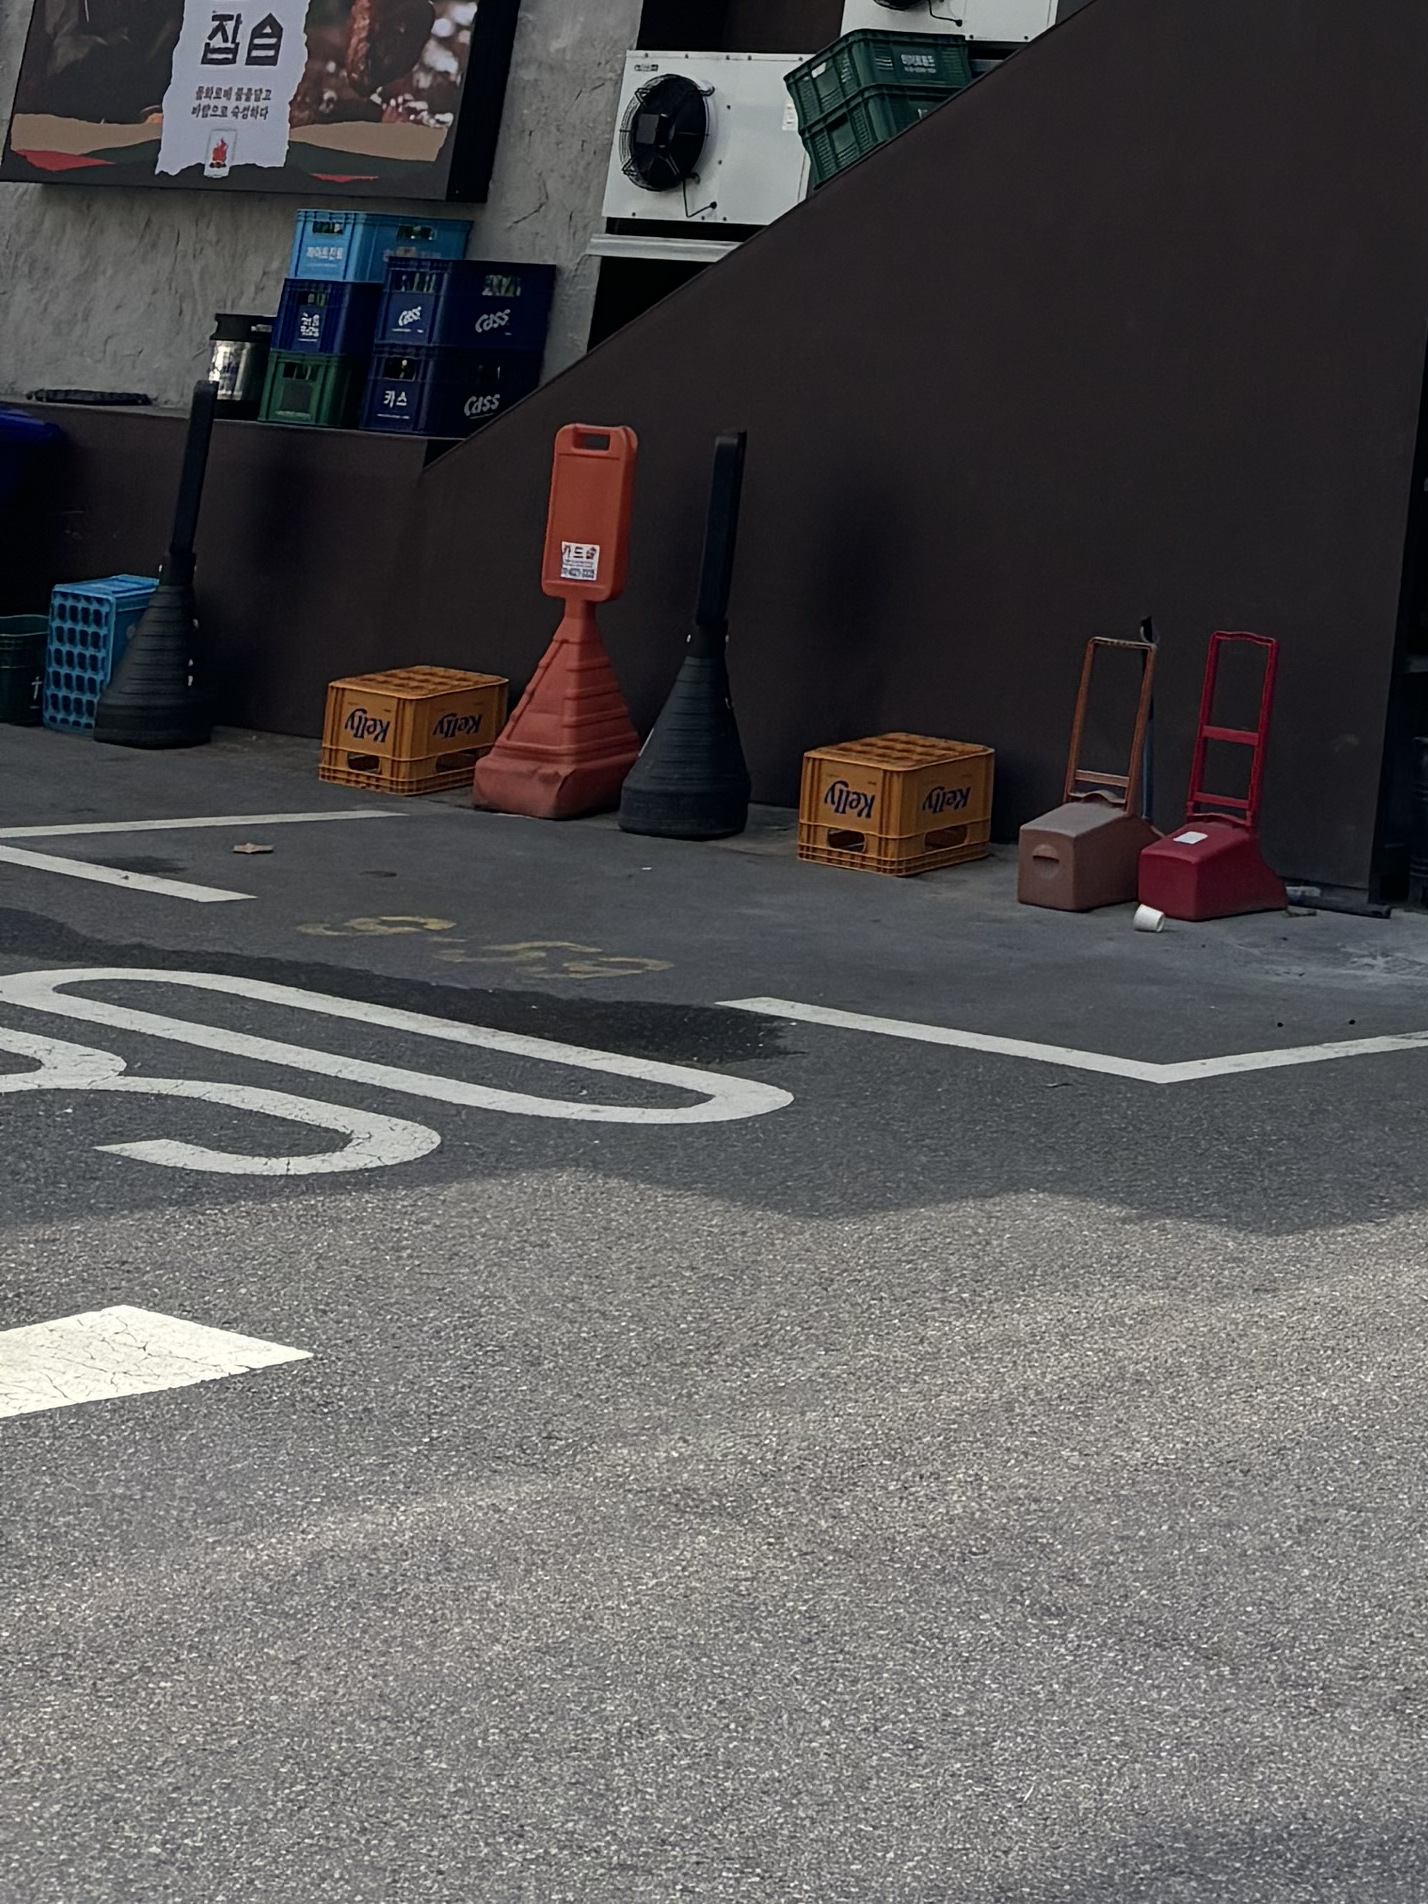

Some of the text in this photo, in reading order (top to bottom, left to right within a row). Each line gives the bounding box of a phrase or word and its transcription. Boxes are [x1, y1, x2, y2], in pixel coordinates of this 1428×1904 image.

[474, 308, 512, 334] Cass
[383, 390, 408, 409] 카스
[463, 394, 501, 417] Cass
[344, 707, 391, 744] Kelly
[432, 712, 483, 739] Kelly
[823, 779, 876, 820] Kelly
[922, 786, 973, 818] Kelly
